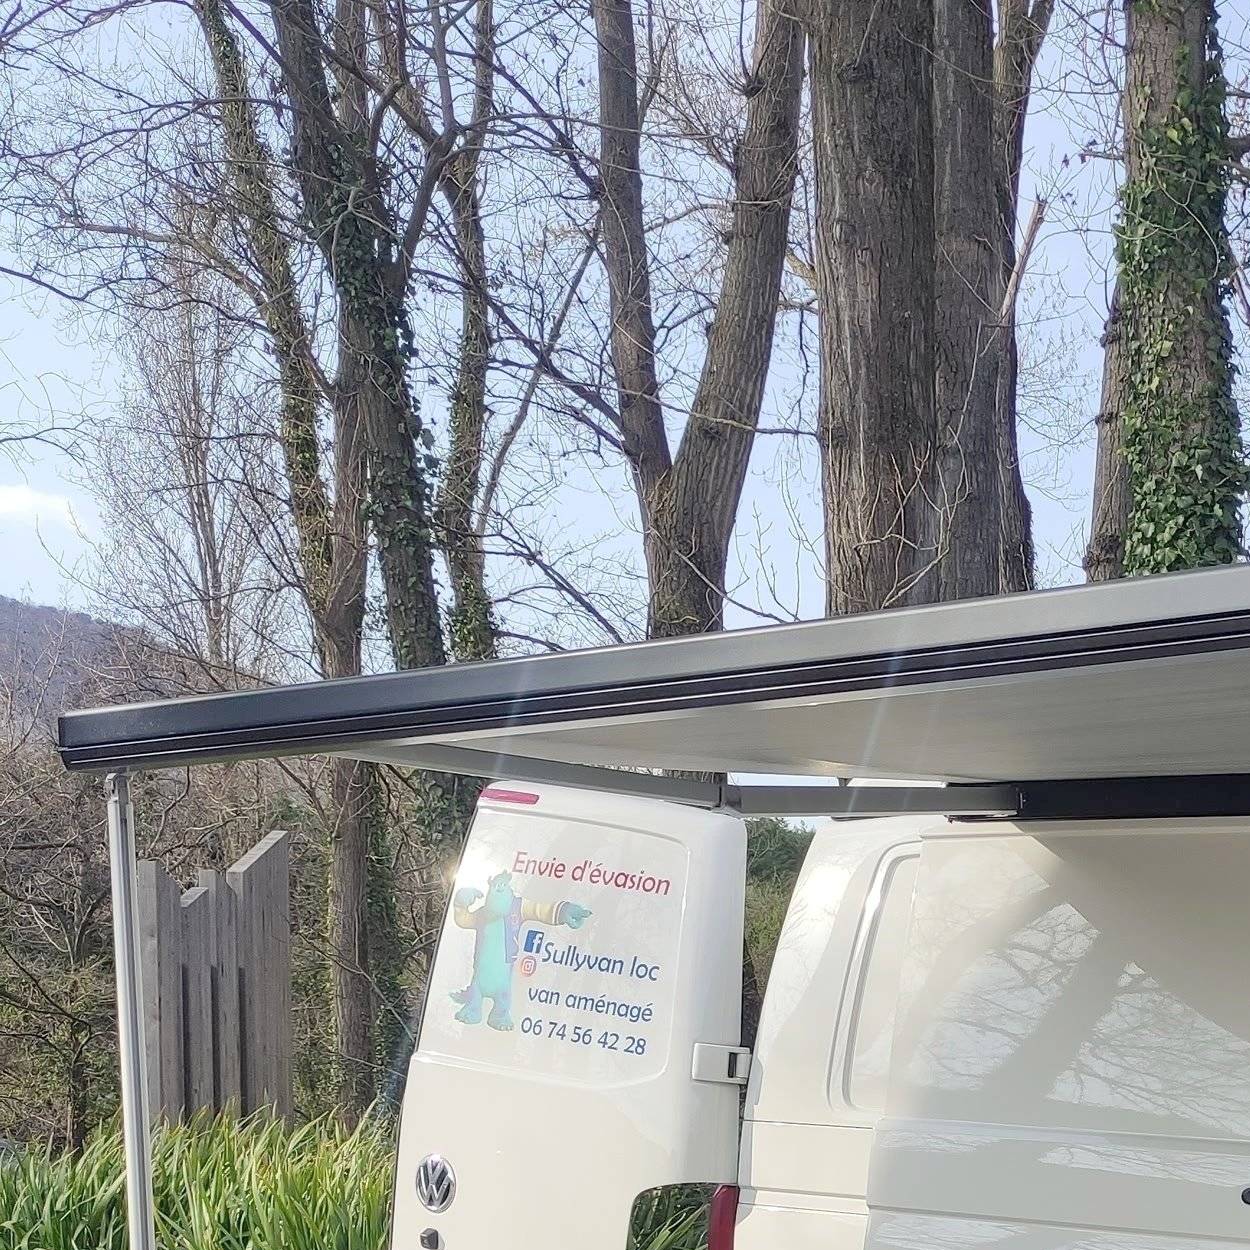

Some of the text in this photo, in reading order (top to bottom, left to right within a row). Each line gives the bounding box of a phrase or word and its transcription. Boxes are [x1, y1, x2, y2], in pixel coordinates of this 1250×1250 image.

[511, 851, 671, 896] Envie d'évasion
[541, 941, 625, 975] Sullyvan
[629, 955, 661, 981] loc
[528, 987, 654, 1023] van aménagé
[521, 1016, 647, 1056] 06 74 56 42 28
[417, 1156, 455, 1211] VW
